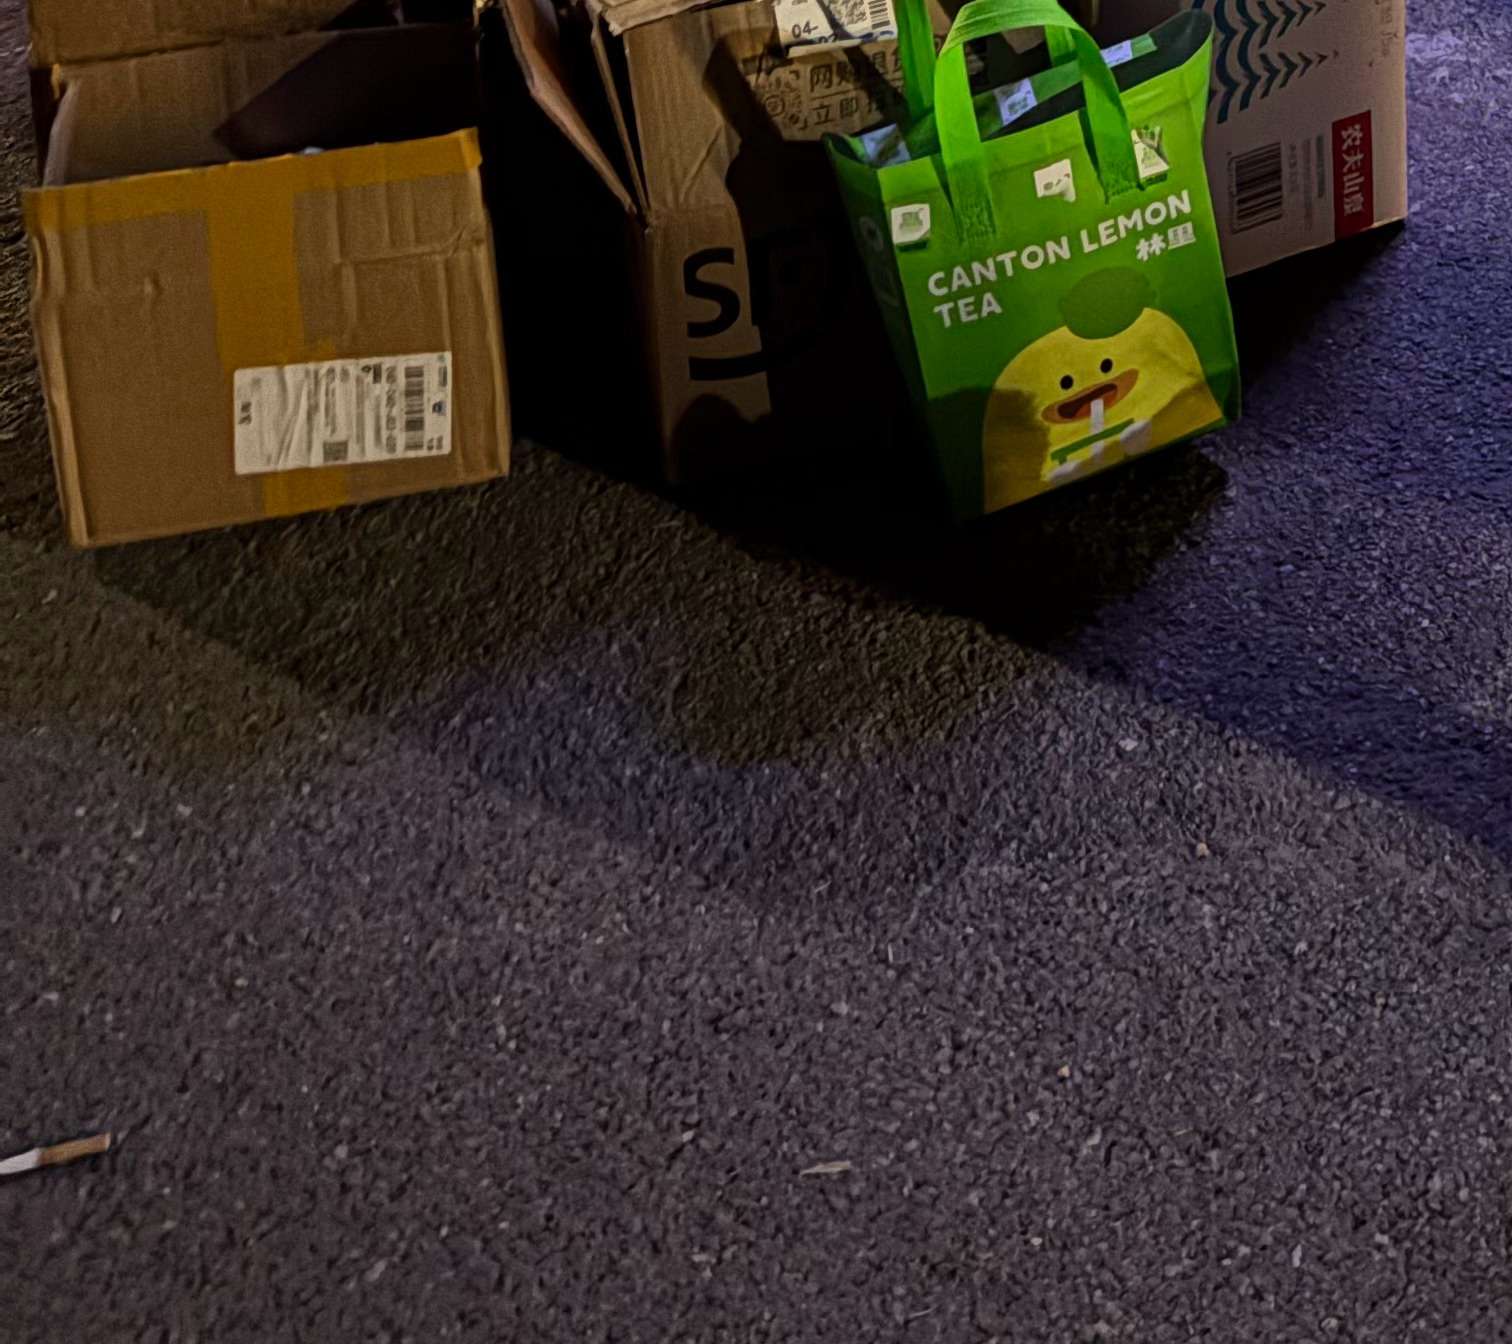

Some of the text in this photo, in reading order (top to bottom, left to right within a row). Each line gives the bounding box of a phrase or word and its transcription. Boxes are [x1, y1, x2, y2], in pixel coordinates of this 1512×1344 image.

[927, 235, 1071, 297] CANTON
[1080, 188, 1192, 254] LEMON
[933, 292, 1003, 329] TEA
